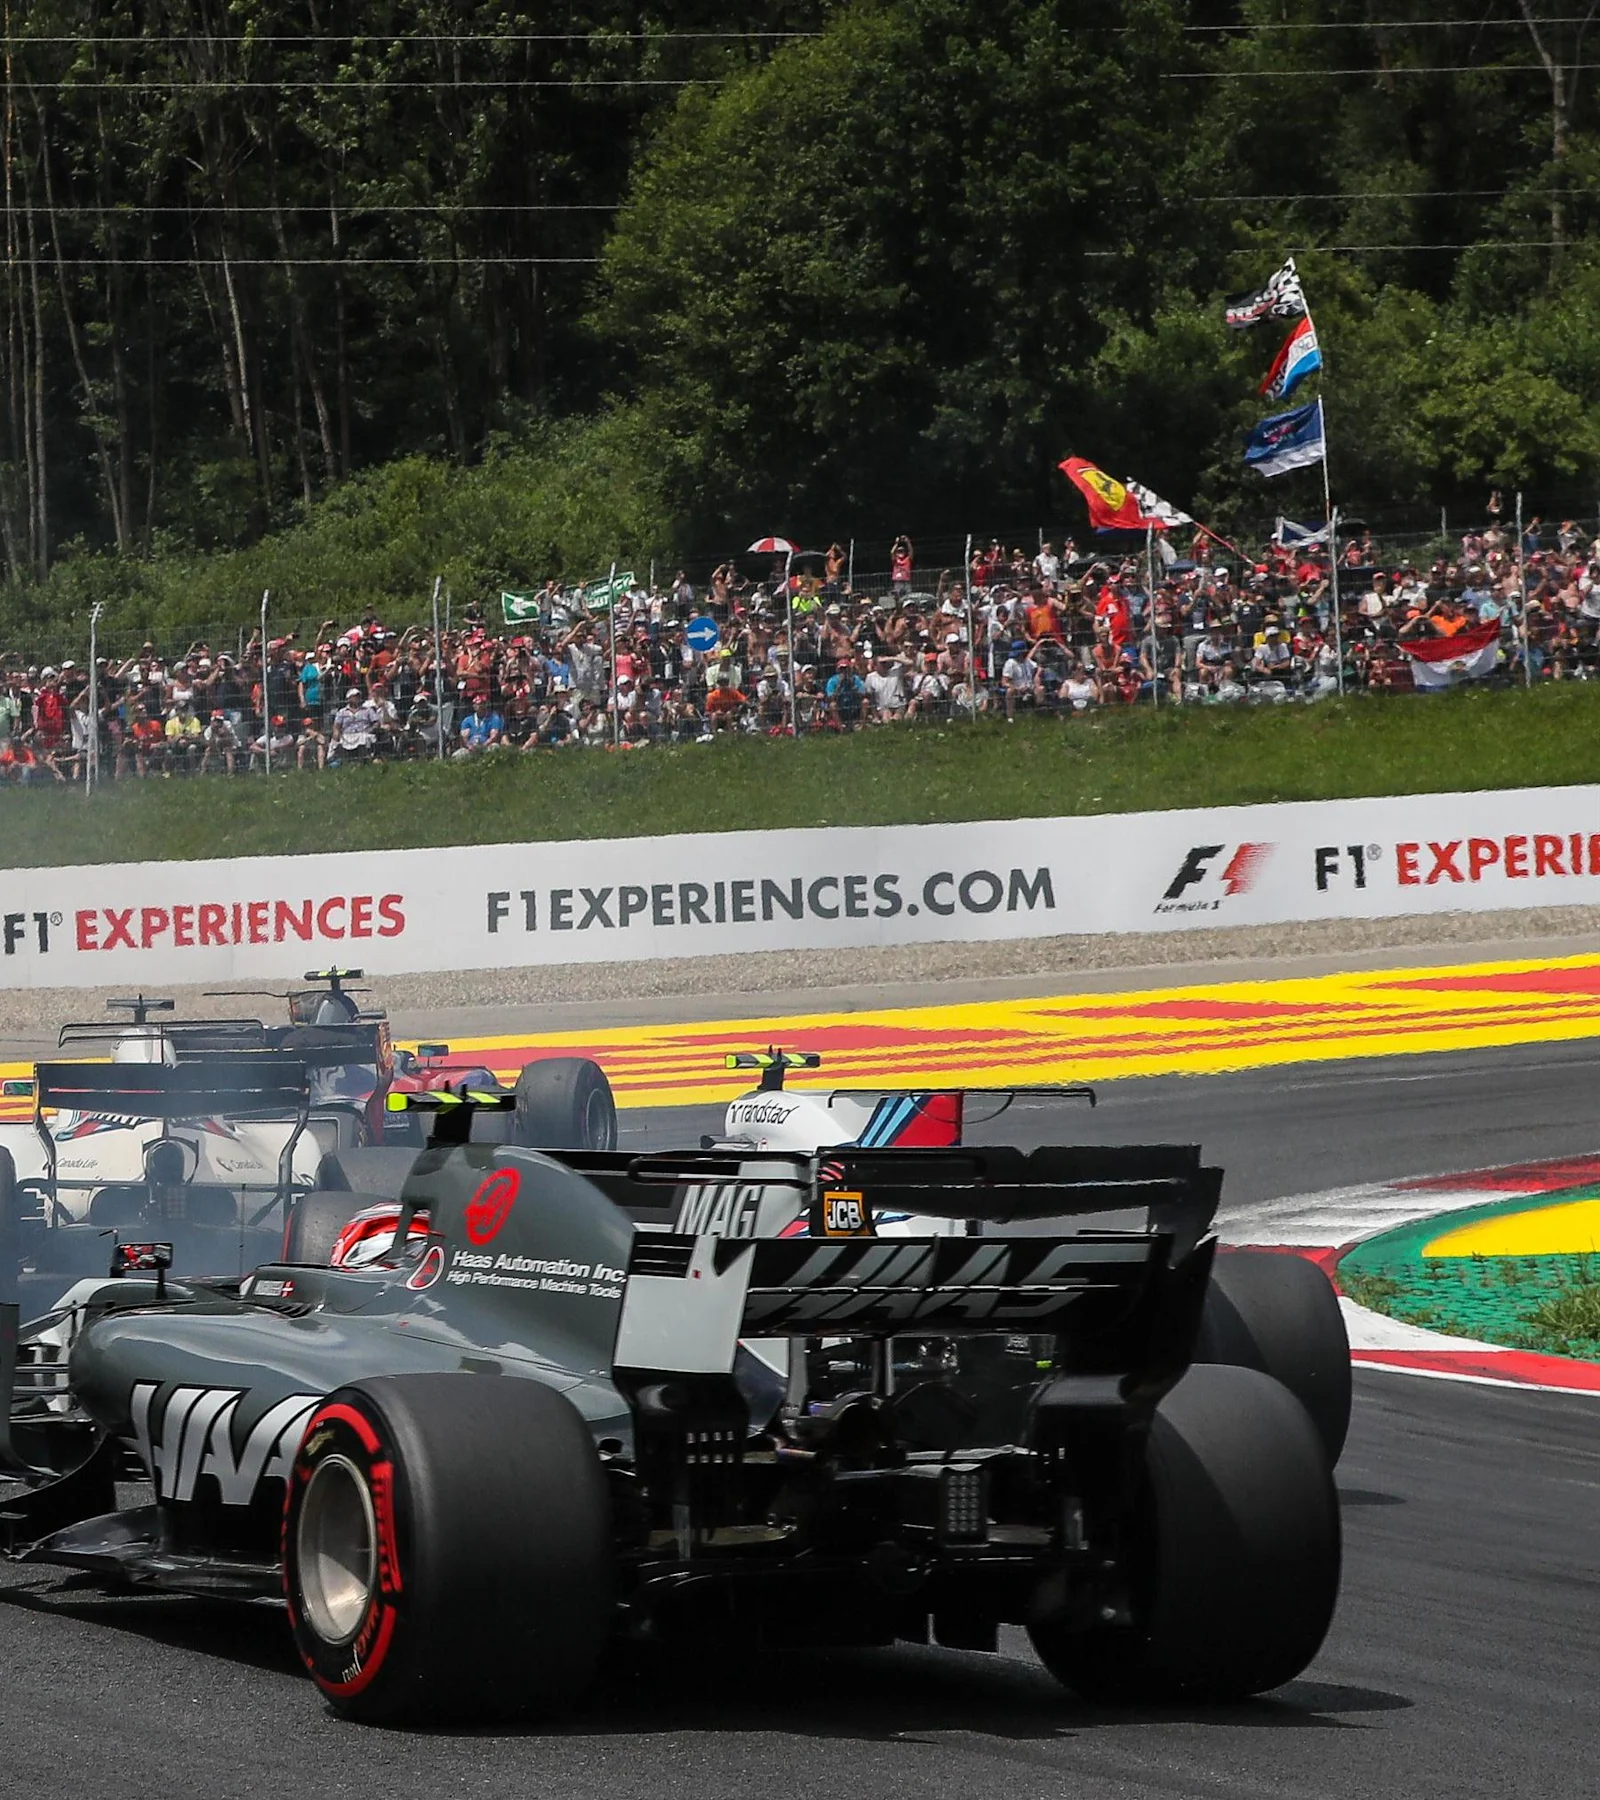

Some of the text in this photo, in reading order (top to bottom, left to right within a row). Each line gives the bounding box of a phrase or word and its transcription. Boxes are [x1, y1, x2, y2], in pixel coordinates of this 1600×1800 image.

[486, 867, 1057, 934] F1EXPERIENCES.COM
[74, 893, 407, 952] EXPERIENCES
[674, 1184, 761, 1238] MAG
[827, 1200, 864, 1229] JCB
[446, 1271, 623, 1299] High Performance Machine Tools
[451, 1250, 627, 1283] Haas Automation Inc.
